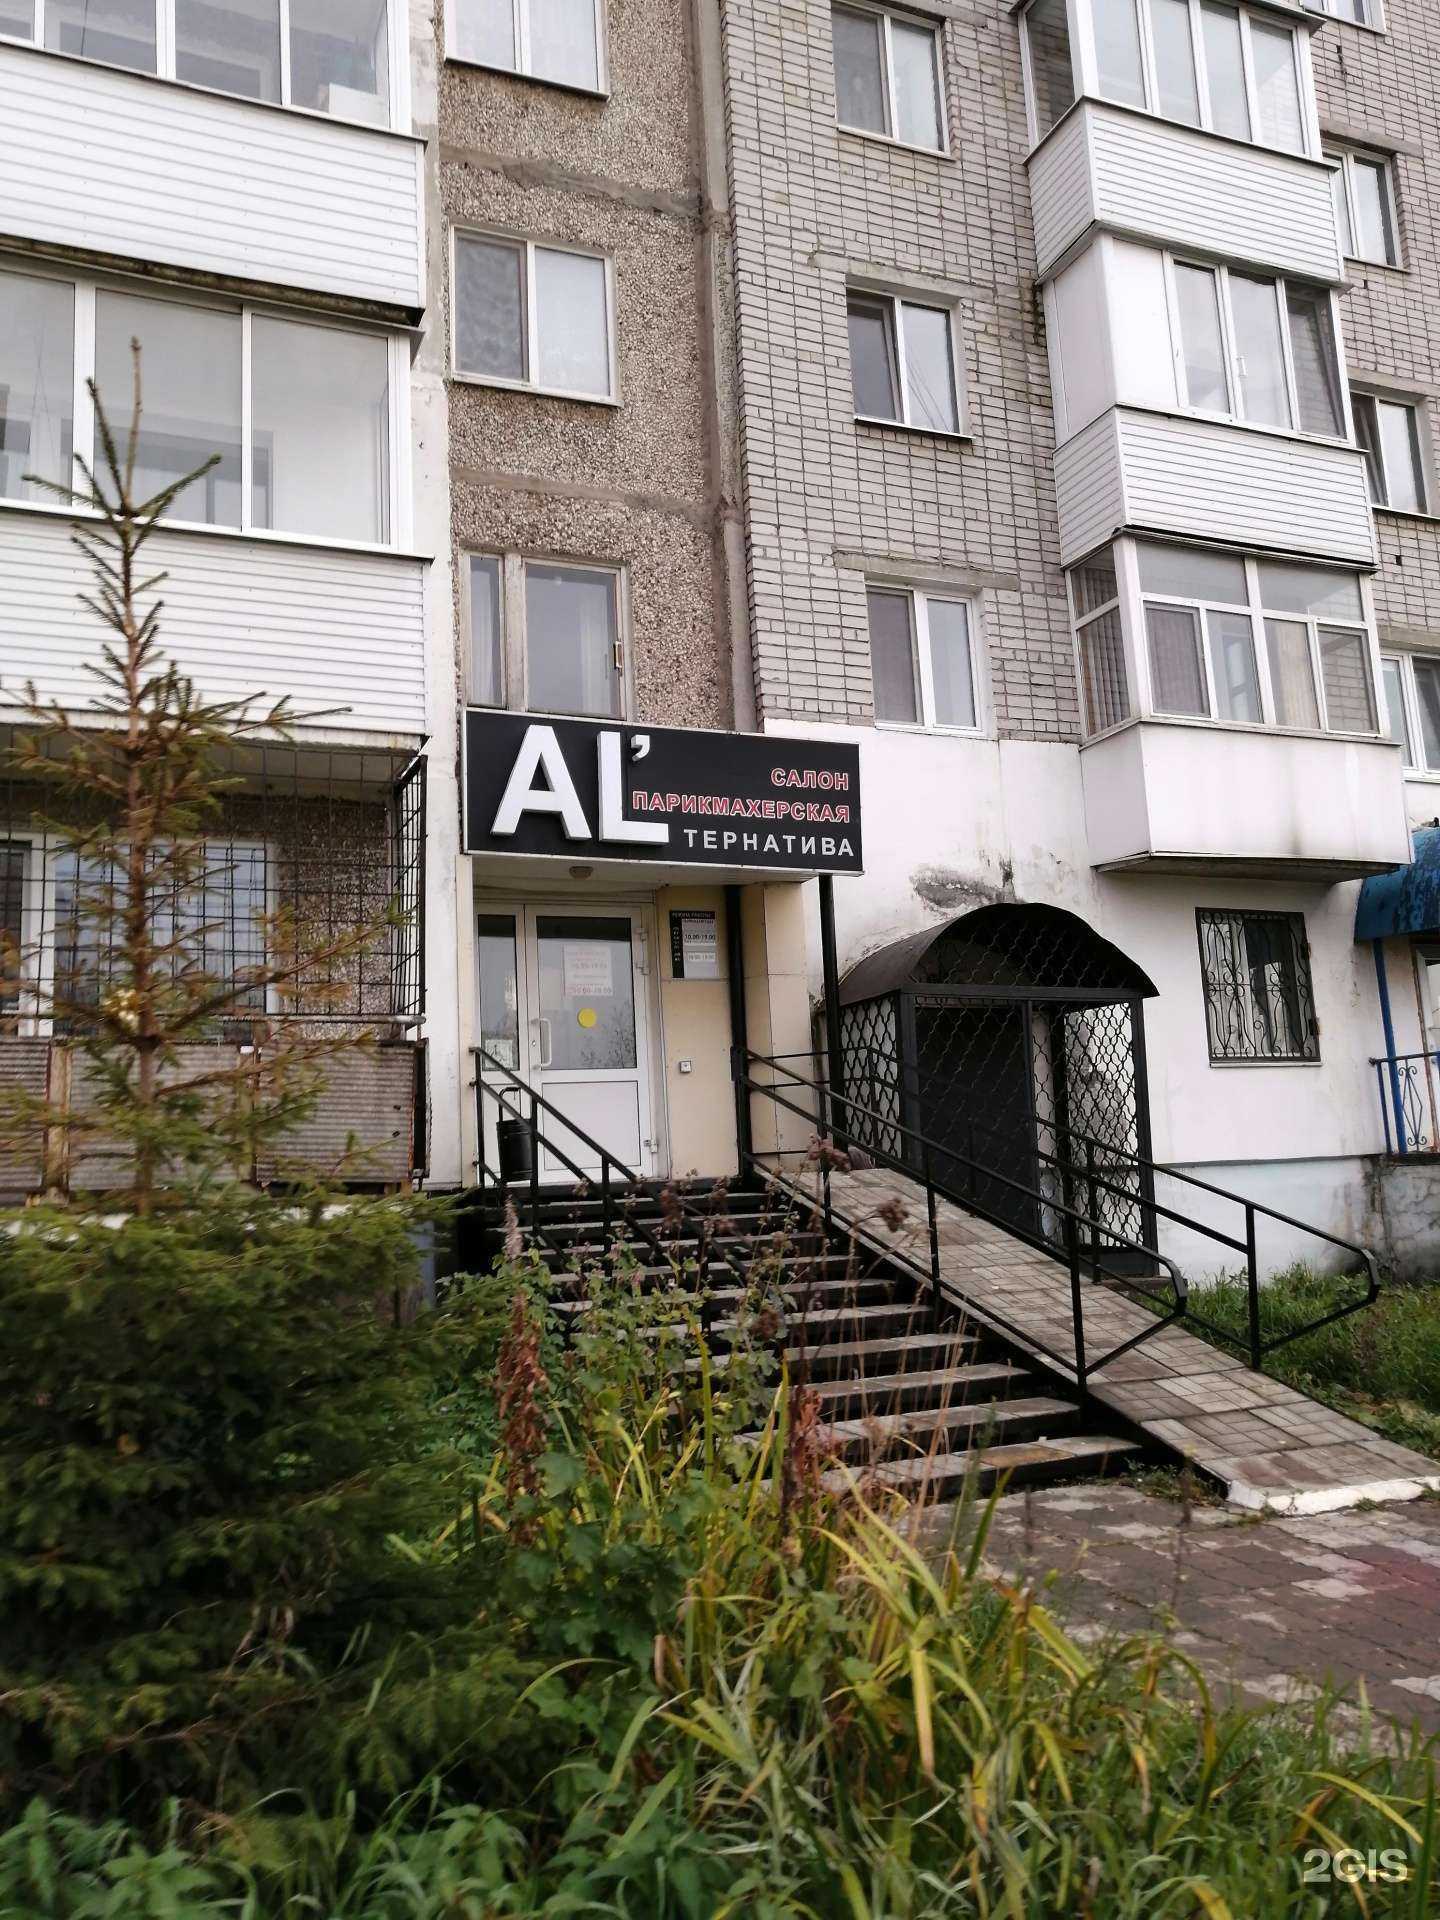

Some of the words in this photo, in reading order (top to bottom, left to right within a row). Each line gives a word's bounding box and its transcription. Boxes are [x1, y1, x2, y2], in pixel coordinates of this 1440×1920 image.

[770, 767, 849, 790] САЛОН
[632, 790, 850, 823] ПАРИКМАХЕРСКАЯ
[683, 828, 854, 857] ТЕРНАТИВА
